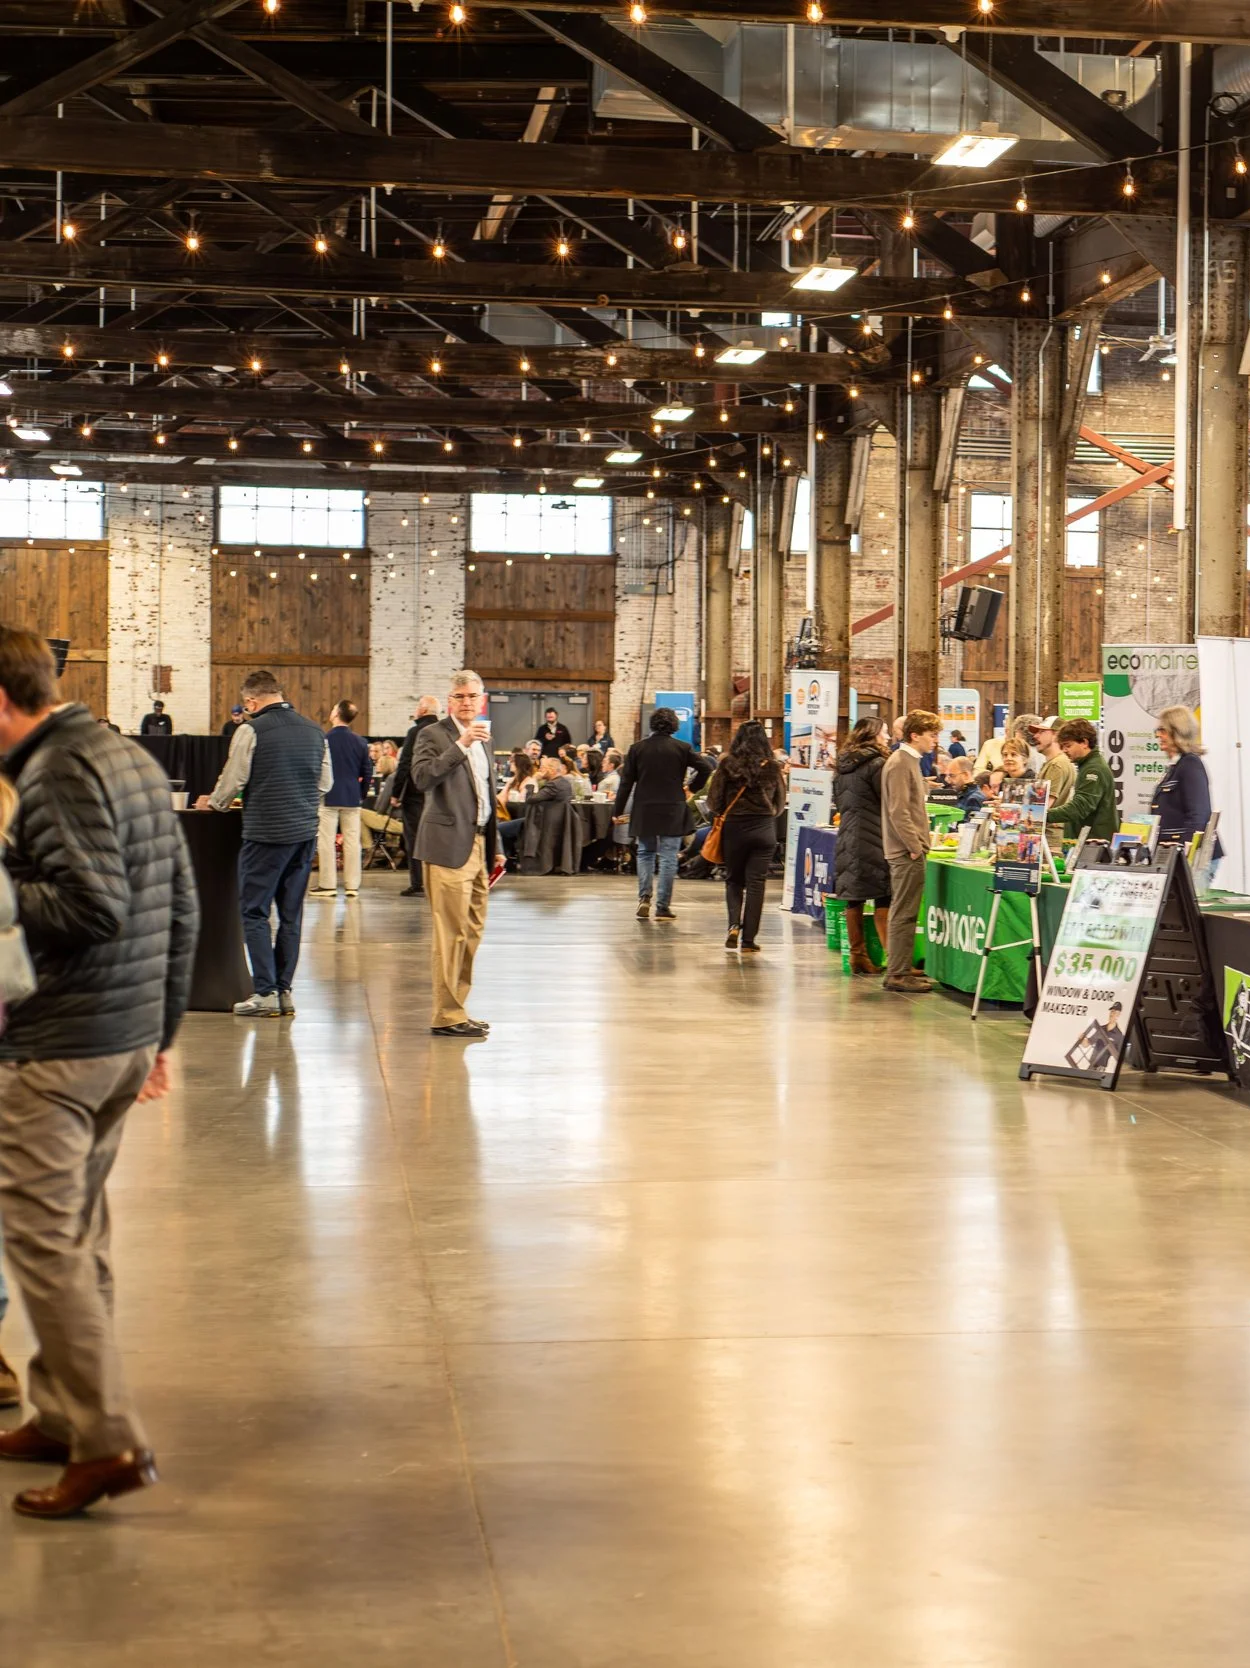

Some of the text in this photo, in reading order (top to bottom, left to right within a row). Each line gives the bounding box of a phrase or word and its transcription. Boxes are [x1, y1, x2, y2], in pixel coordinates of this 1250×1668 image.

[1107, 651, 1198, 670] ecomaine
[1046, 985, 1115, 1002] WINDOW & DOOR
[1041, 1002, 1088, 1016] MAKEOVER
